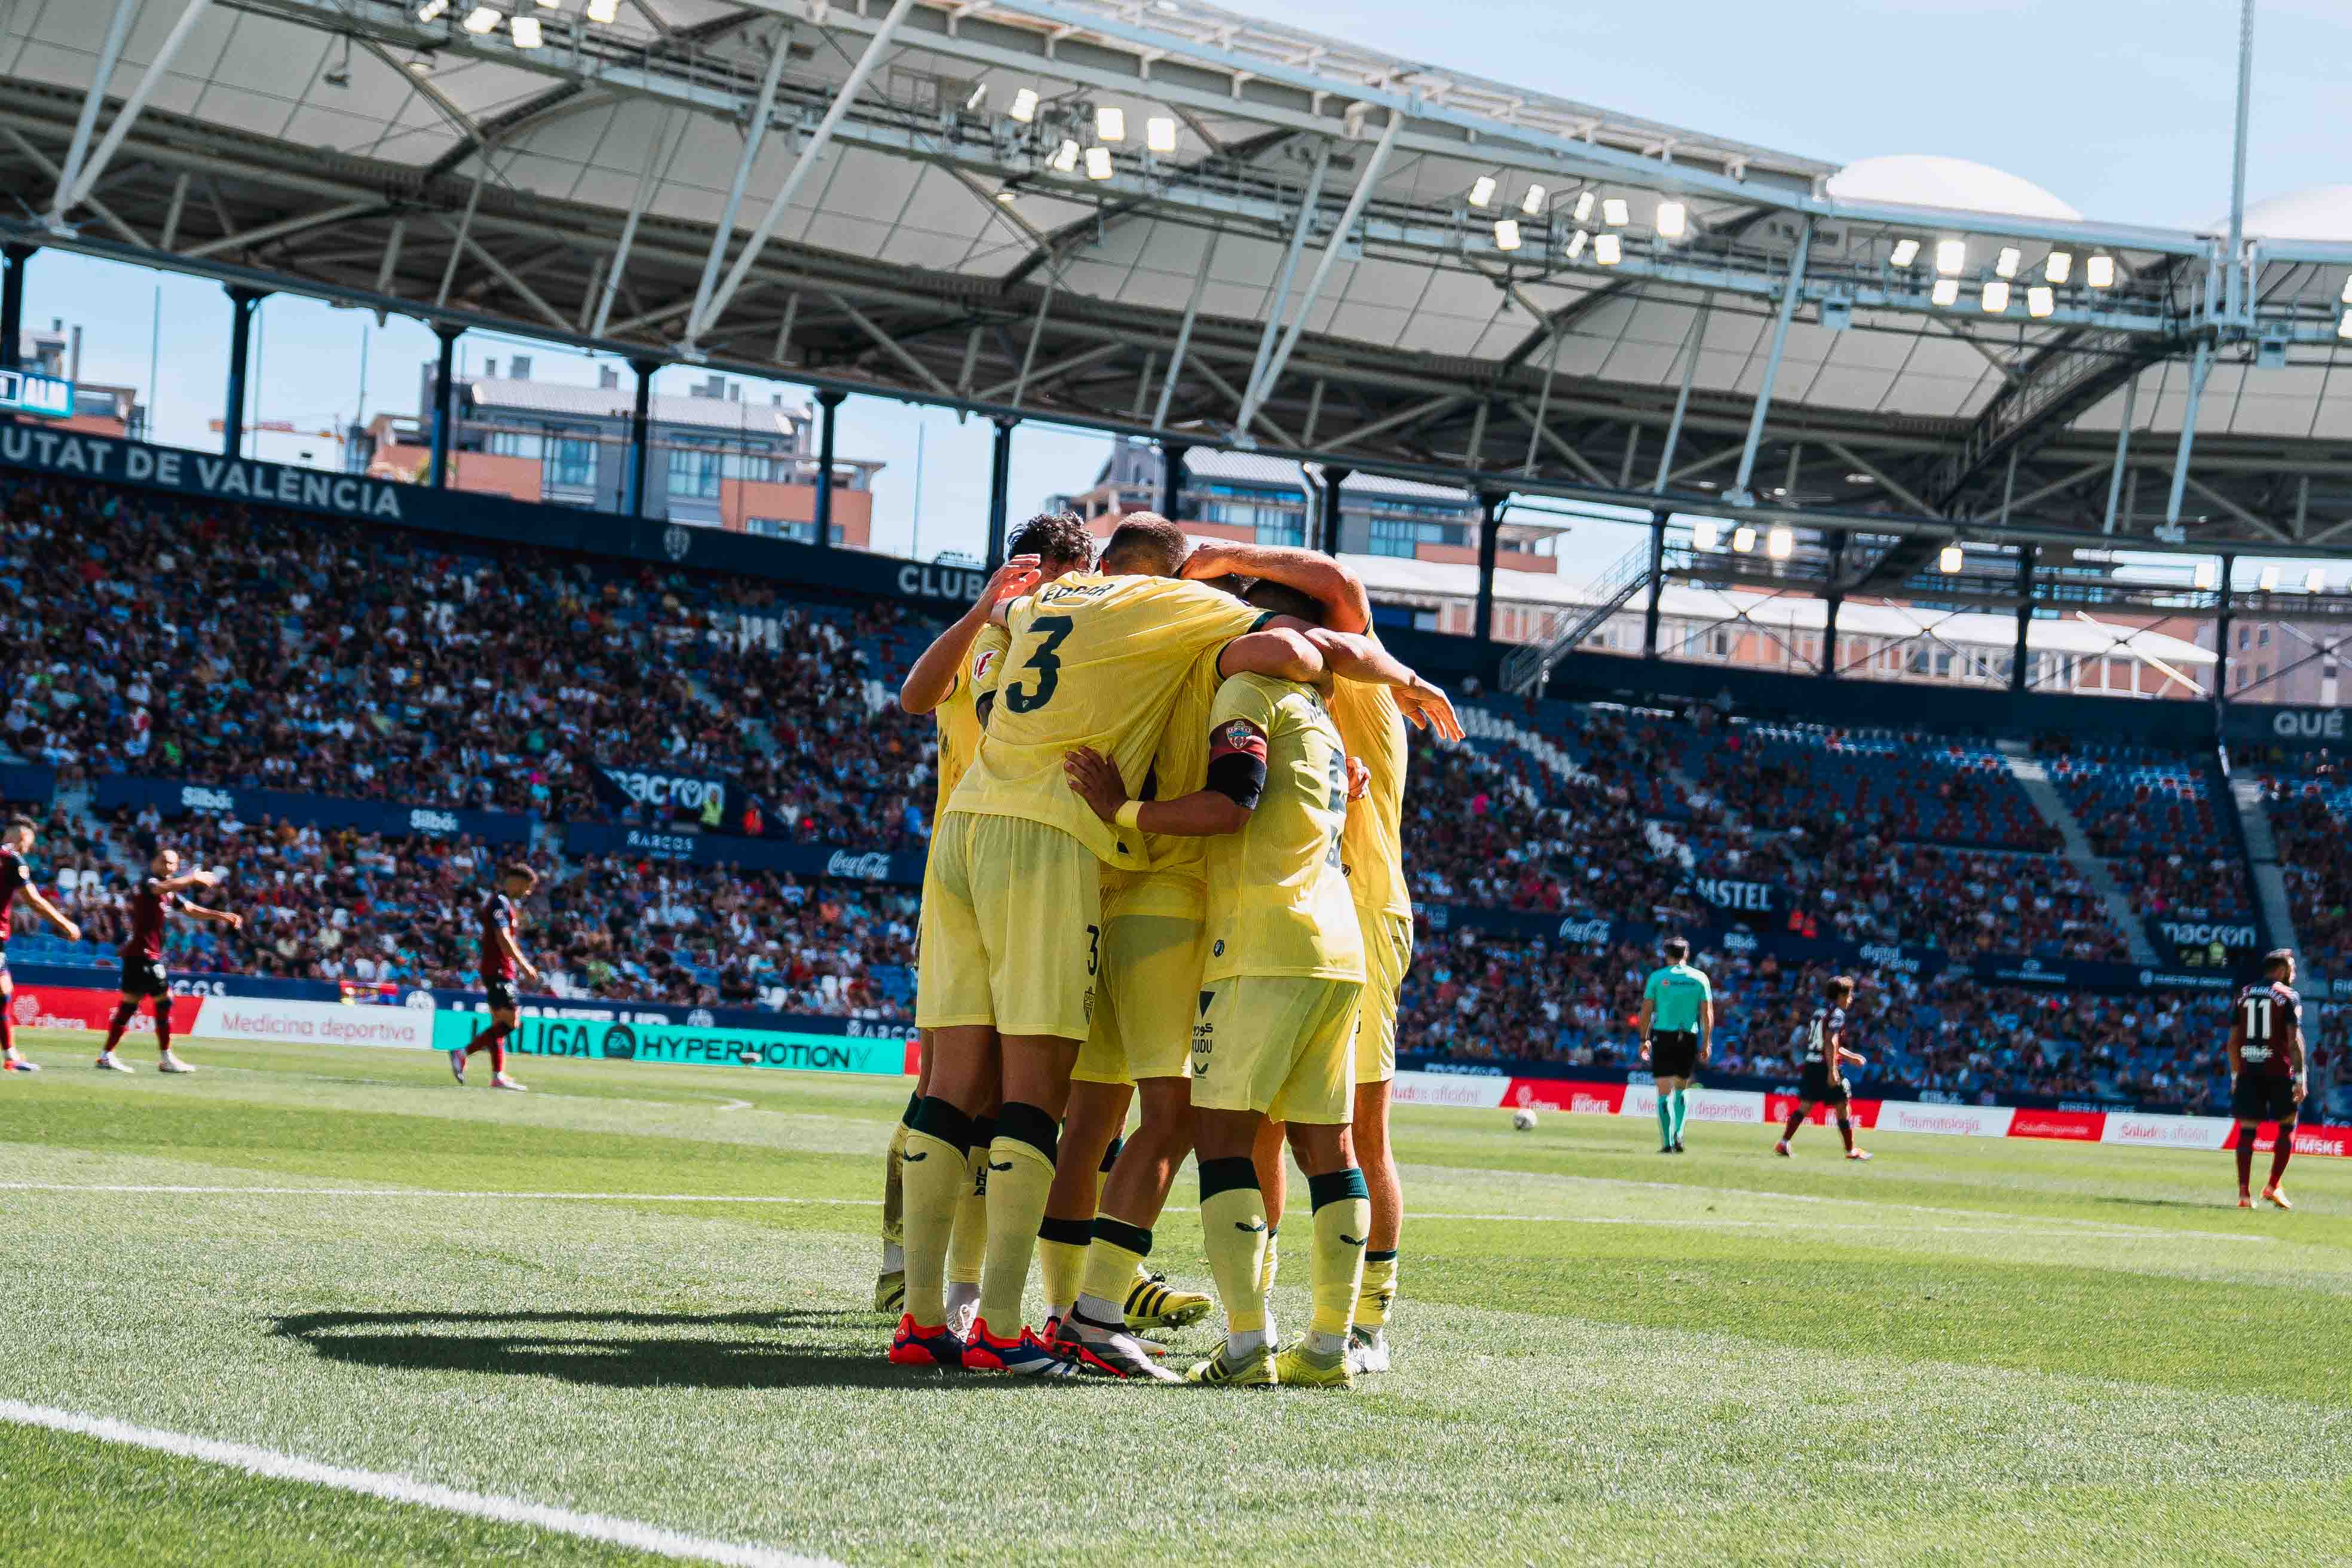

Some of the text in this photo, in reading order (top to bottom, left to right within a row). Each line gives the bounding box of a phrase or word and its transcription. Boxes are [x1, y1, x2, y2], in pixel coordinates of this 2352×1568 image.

[2, 427, 114, 473] UTAT
[125, 447, 181, 485] DE
[898, 564, 985, 600] CLUB
[1004, 615, 1074, 713] 3
[627, 830, 694, 851] MARCOS
[1086, 924, 1100, 976] 3
[221, 1013, 416, 1042] Medicina deportiva
[2242, 998, 2271, 1040] 11
[471, 1017, 590, 1058] LIGA
[644, 1035, 850, 1070] HYPERMOTION
